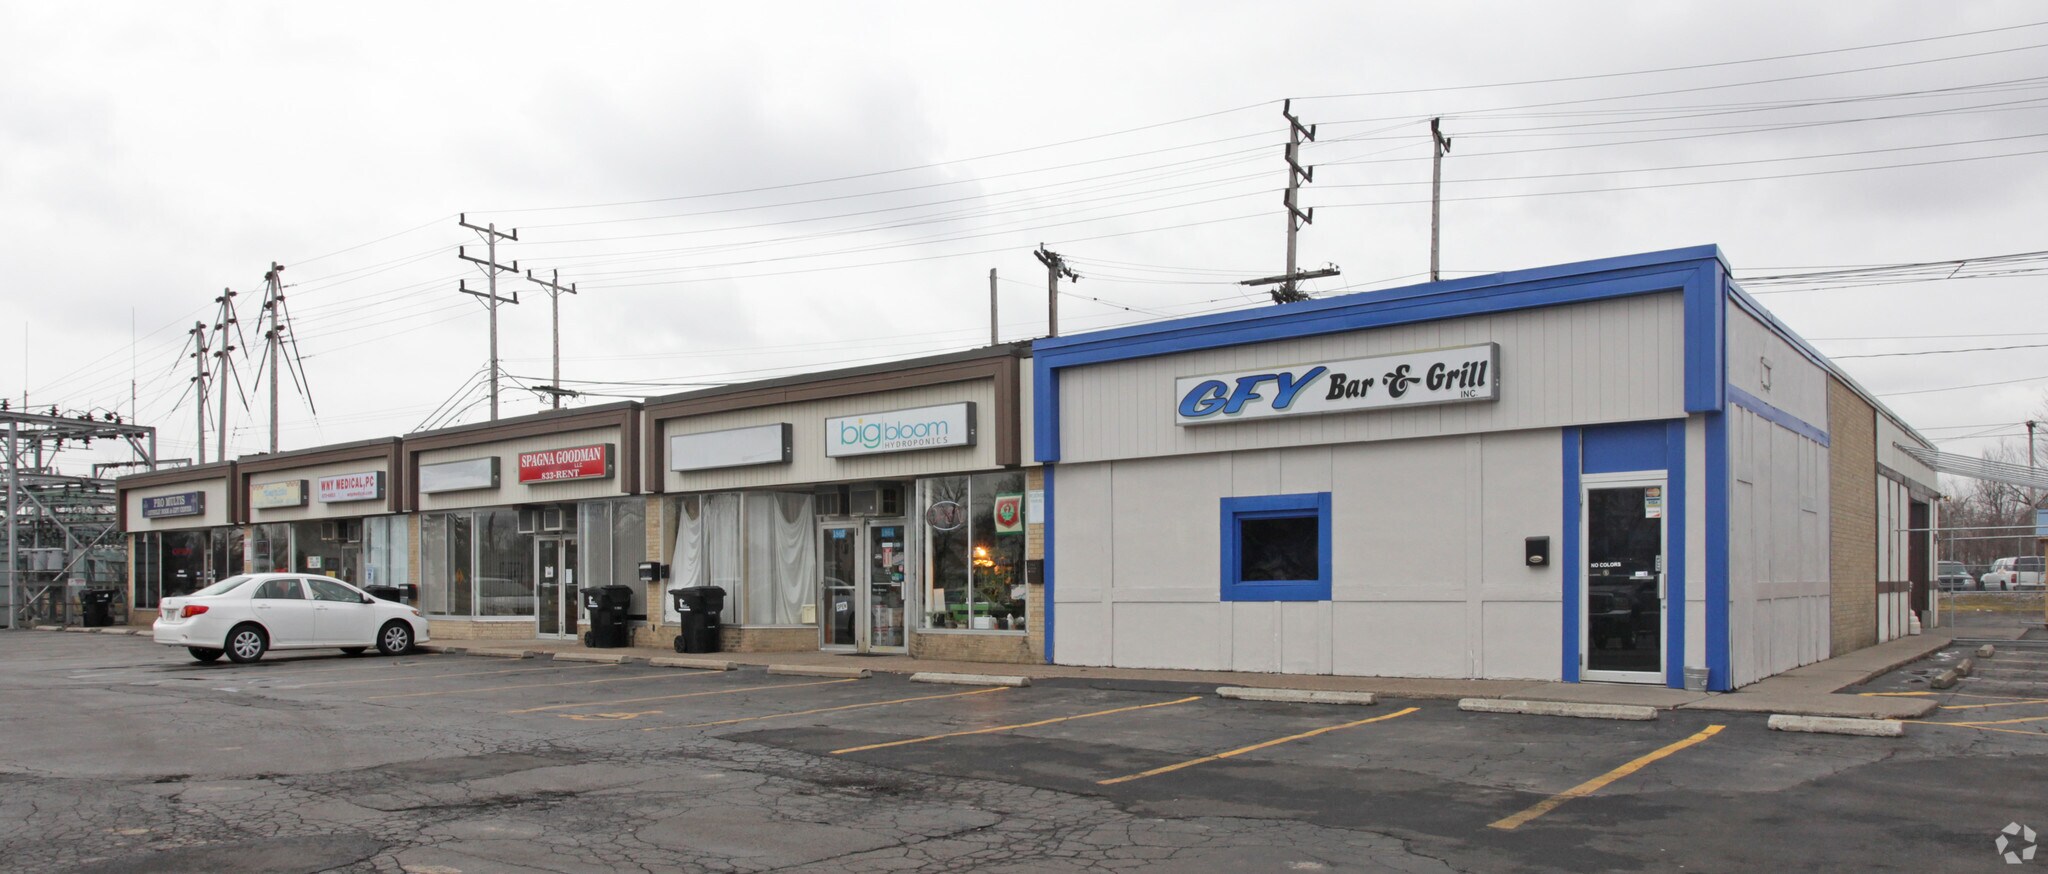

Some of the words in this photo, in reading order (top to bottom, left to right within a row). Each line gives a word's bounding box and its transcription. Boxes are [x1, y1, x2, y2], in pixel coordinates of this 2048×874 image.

[1179, 366, 1328, 418] GFY
[1325, 373, 1374, 400] Bar
[1382, 364, 1421, 398] &
[1426, 360, 1488, 391] Grill
[1460, 390, 1478, 398] INC.
[841, 418, 881, 449] big
[885, 421, 948, 440] bloom
[885, 436, 948, 449] HYDROPONICS
[521, 452, 555, 468] SPAGNA
[556, 447, 601, 464] GOODMAN
[541, 469, 580, 480] 833-RENT
[321, 480, 334, 491] WNY
[153, 498, 165, 508] PRO
[837, 602, 847, 610] OPEN
